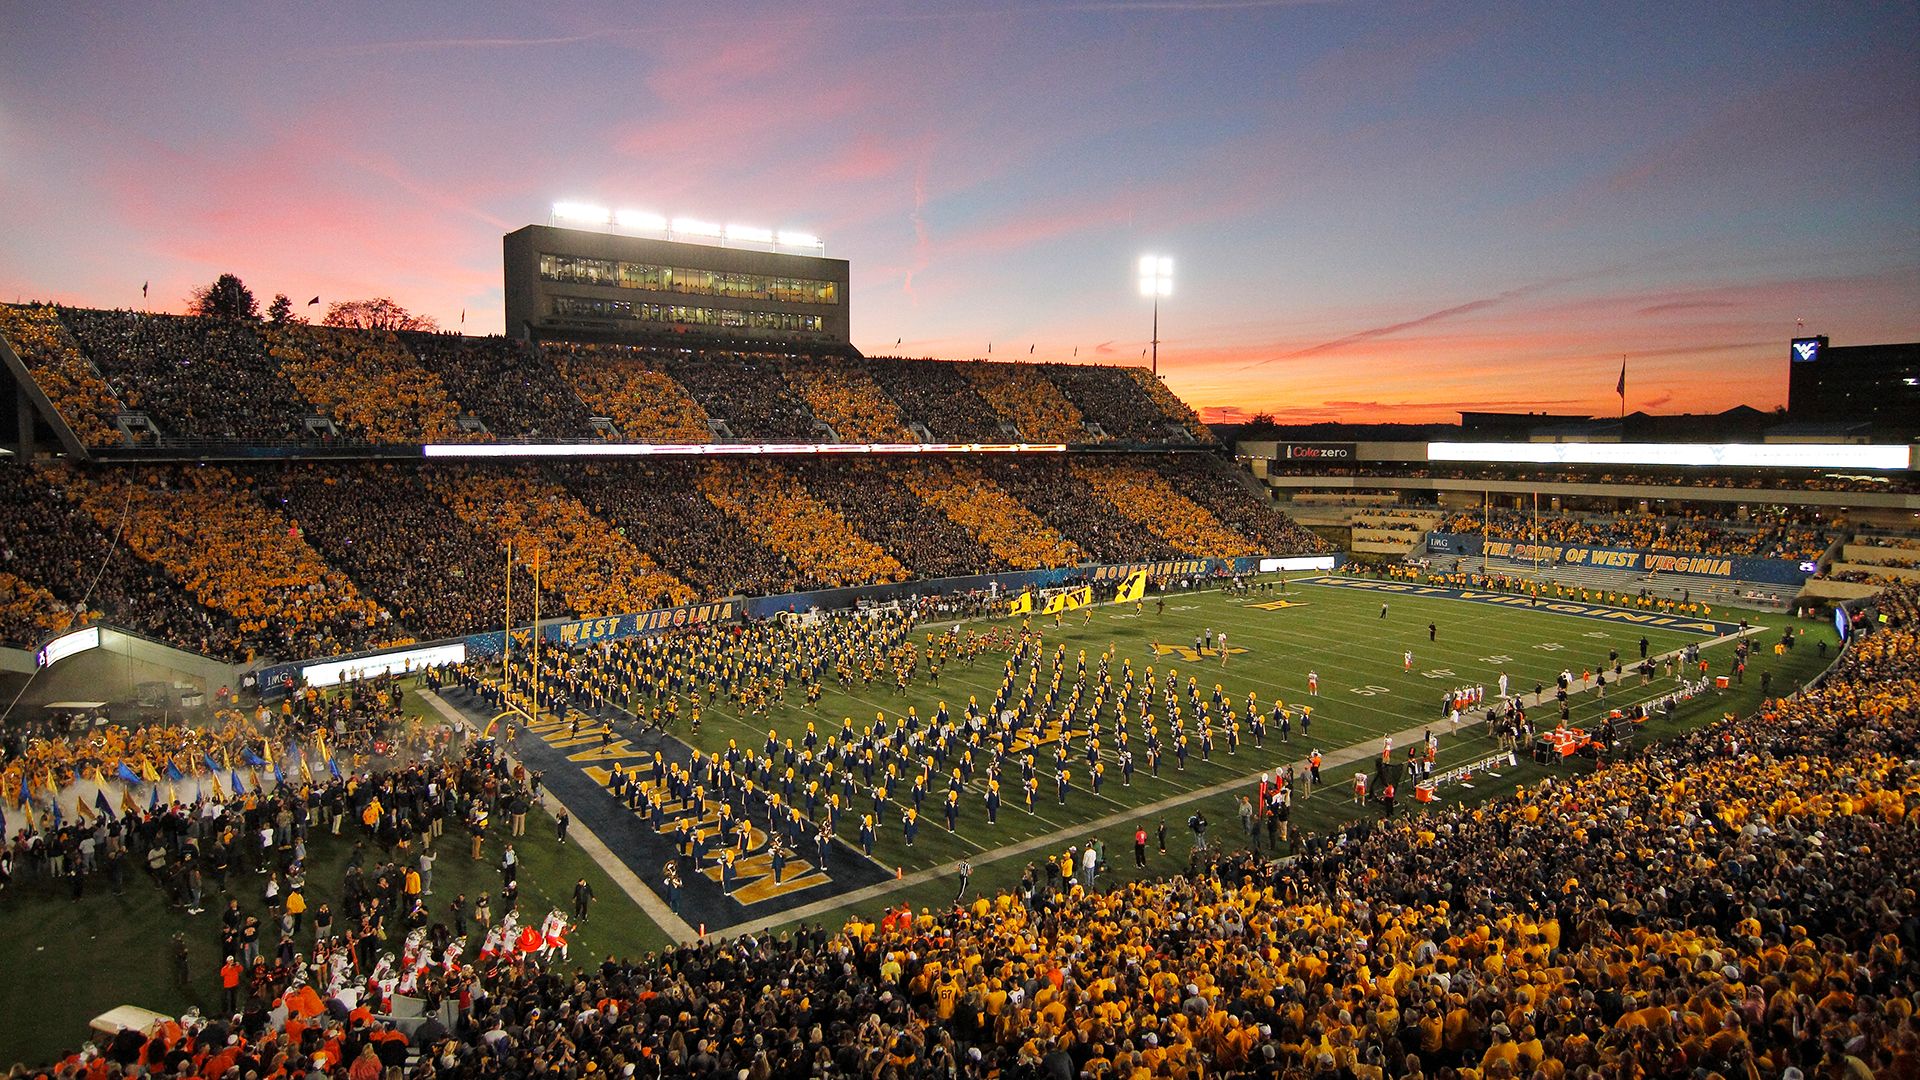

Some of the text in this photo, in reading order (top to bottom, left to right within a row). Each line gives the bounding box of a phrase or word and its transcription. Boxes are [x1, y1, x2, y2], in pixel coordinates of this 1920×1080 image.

[1293, 446, 1347, 458] Coke zero
[1430, 538, 1448, 547] IMG
[1482, 541, 1732, 576] THE PRIDE OF WEST VIRGINIA
[1095, 560, 1206, 580] MOUNTAINEERS
[1459, 591, 1716, 632] VIRGINIA
[560, 603, 732, 641] WEST VIRGINIA
[267, 672, 288, 687] IMG
[1350, 685, 1390, 696] 50
[941, 990, 952, 1000] 67
